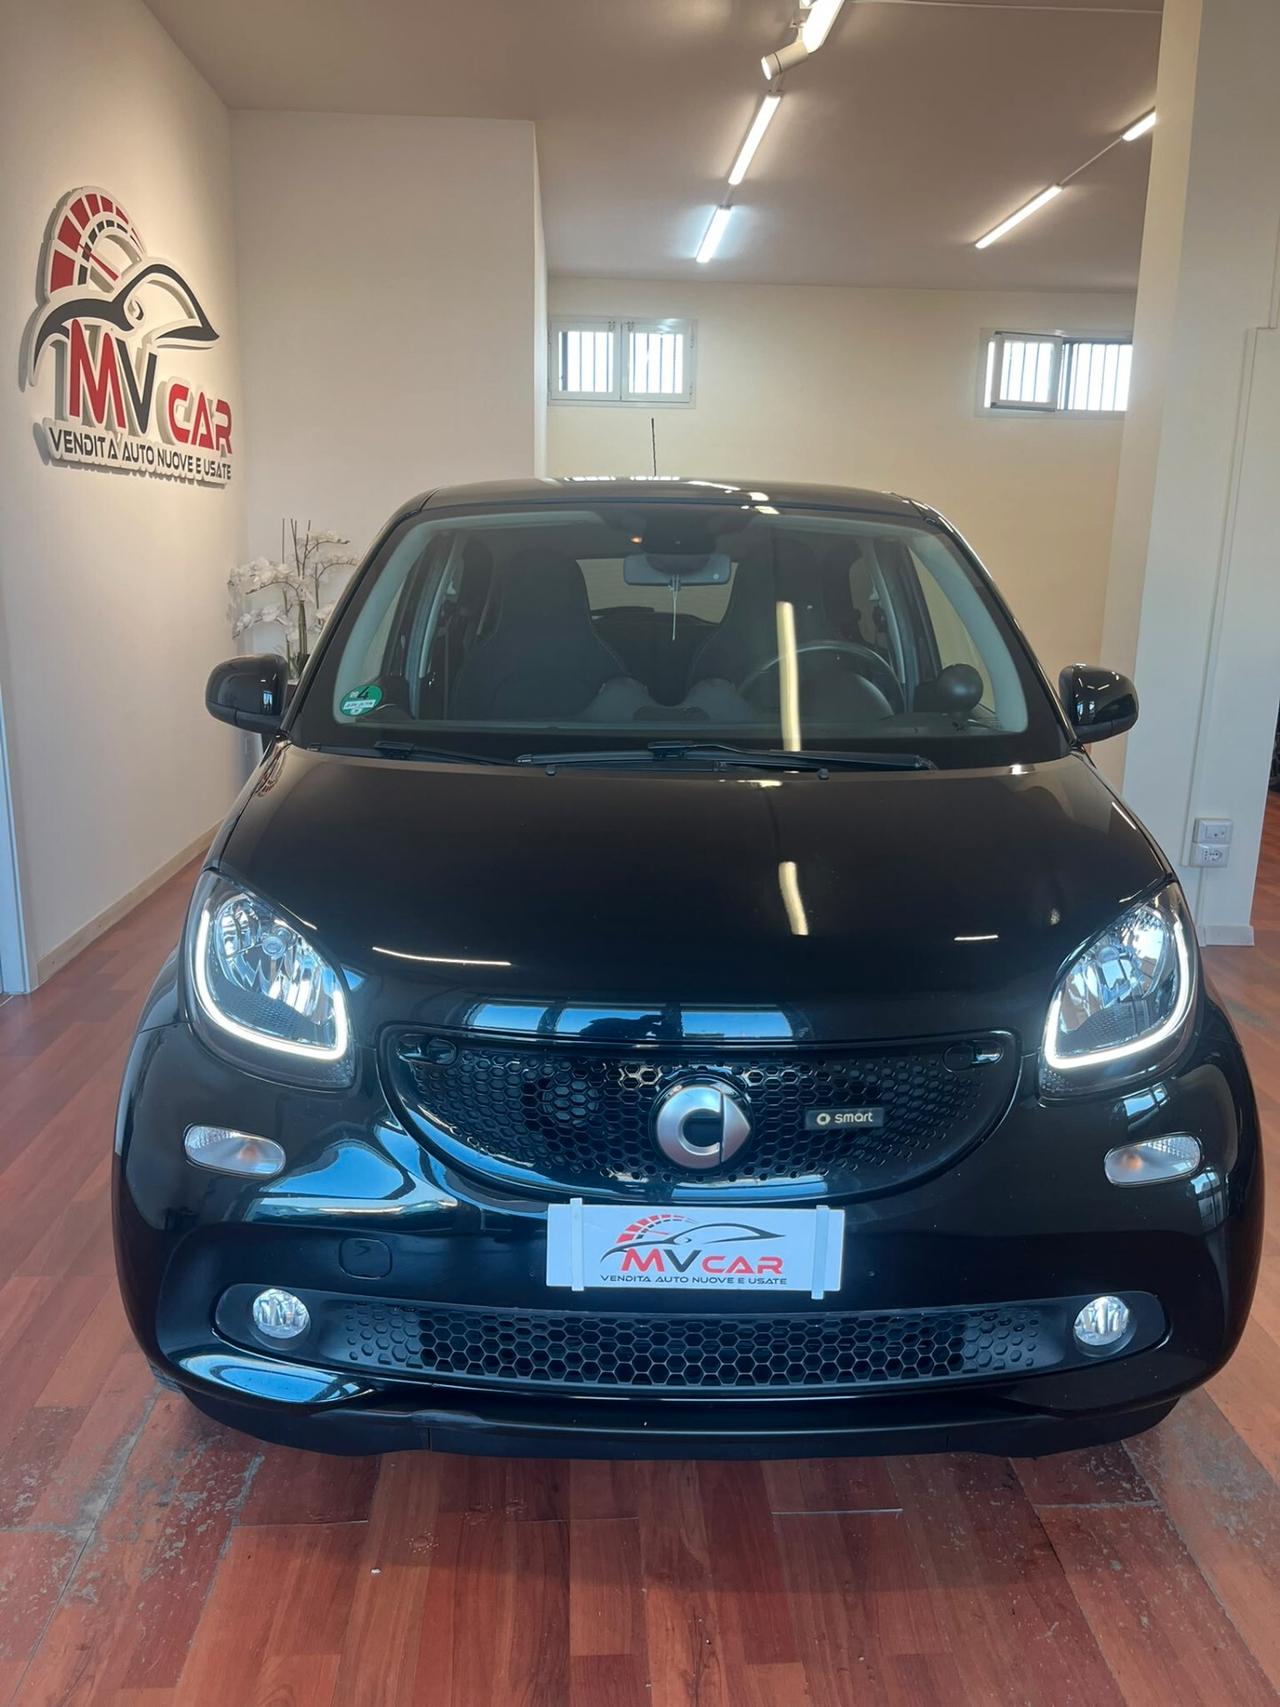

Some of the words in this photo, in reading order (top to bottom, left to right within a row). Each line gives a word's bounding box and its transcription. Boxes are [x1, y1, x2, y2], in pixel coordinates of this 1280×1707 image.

[48, 426, 118, 460] VENDITA
[121, 442, 155, 465] AUTO
[156, 448, 193, 473] NUOVE
[196, 457, 202, 473] E
[203, 458, 232, 480] USATE
[834, 1112, 873, 1123] smart
[599, 1274, 652, 1283] VENDITA
[655, 1275, 689, 1284] AUTO
[691, 1276, 735, 1284] NUOVE
[748, 1277, 788, 1285] USATE
